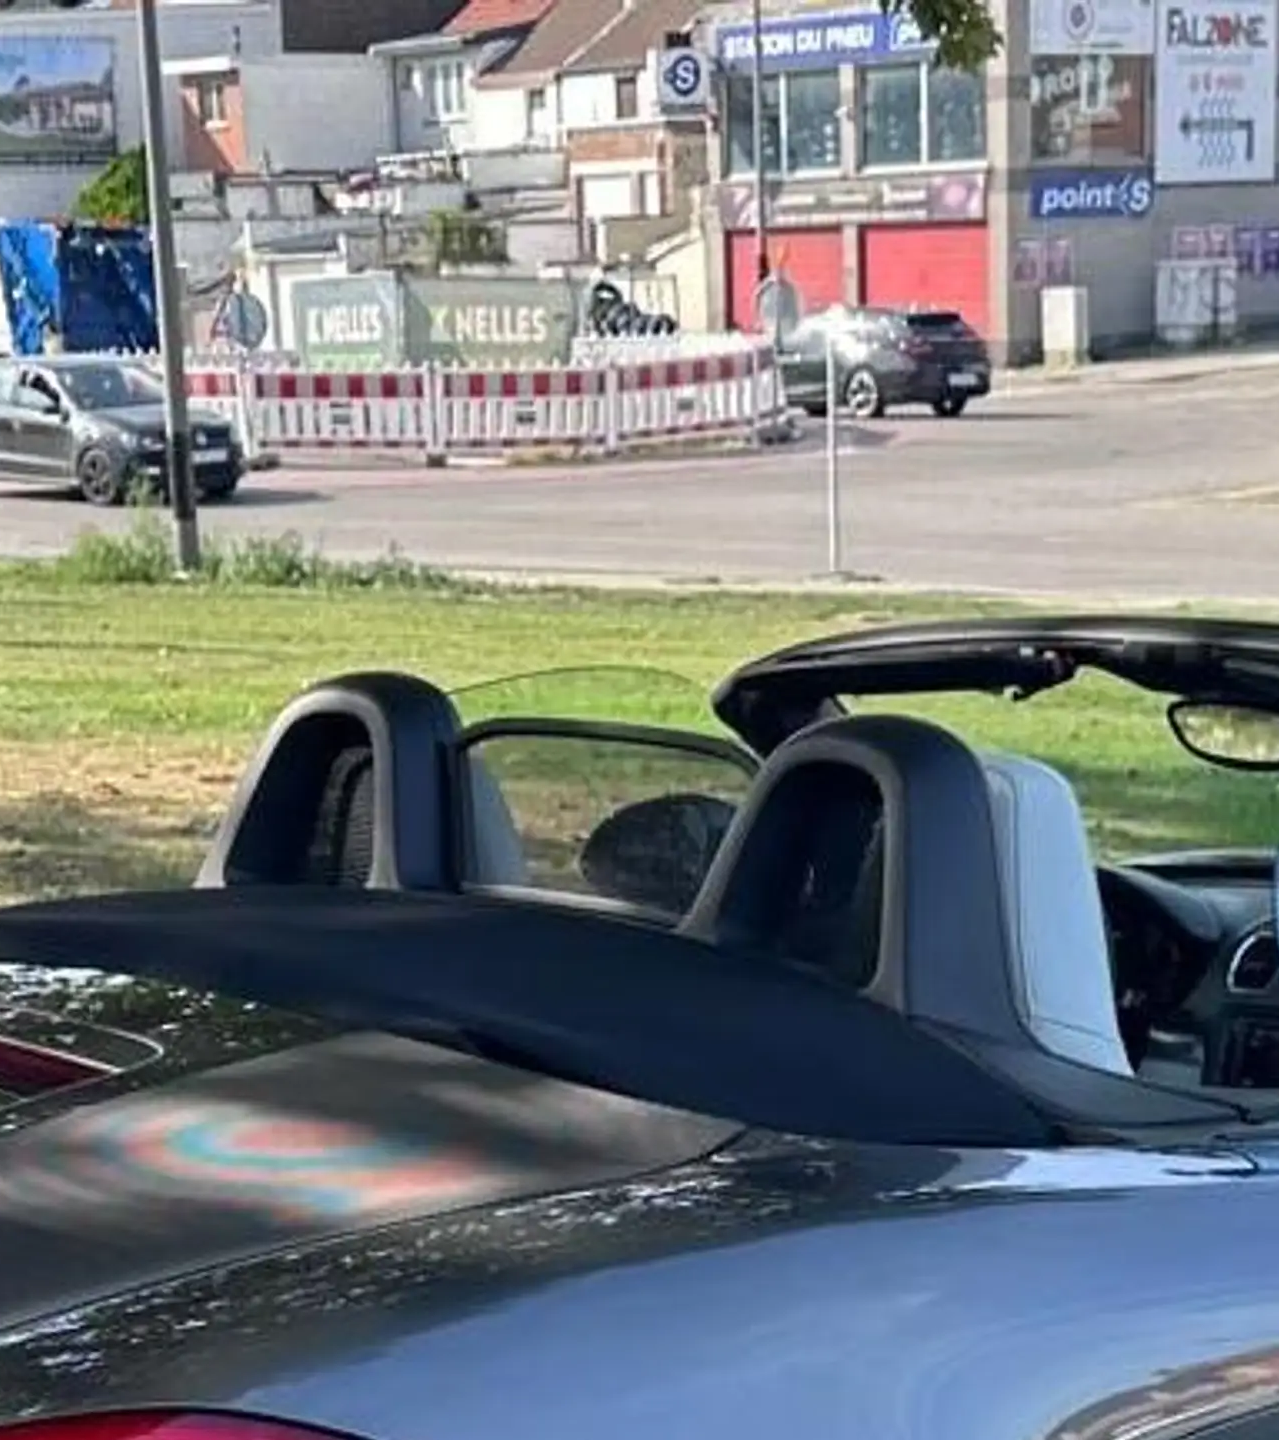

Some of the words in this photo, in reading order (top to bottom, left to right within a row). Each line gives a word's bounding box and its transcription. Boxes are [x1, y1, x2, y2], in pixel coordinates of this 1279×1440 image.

[825, 23, 875, 50] PNEU
[675, 59, 695, 90] S
[1040, 180, 1119, 215] point
[1129, 177, 1151, 212] S
